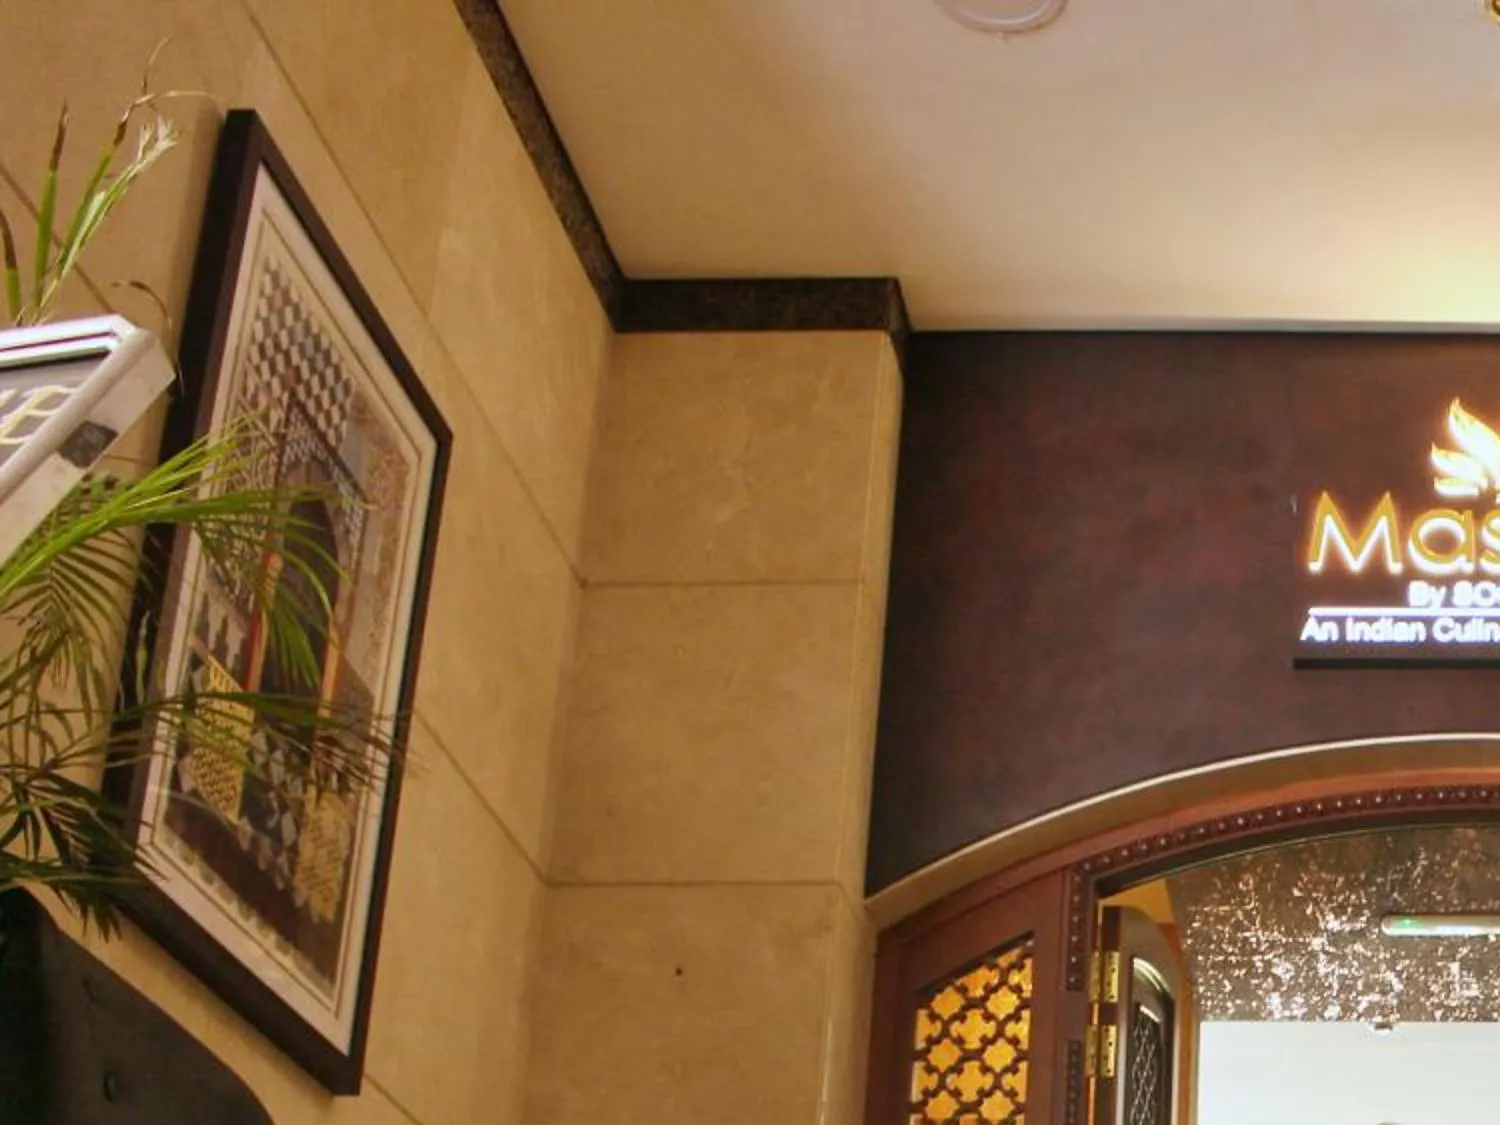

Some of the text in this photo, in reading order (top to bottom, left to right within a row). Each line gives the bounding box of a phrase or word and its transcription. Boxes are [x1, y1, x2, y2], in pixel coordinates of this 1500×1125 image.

[1408, 580, 1446, 608] By
[1300, 615, 1340, 642] An
[1345, 616, 1427, 643] Indian
